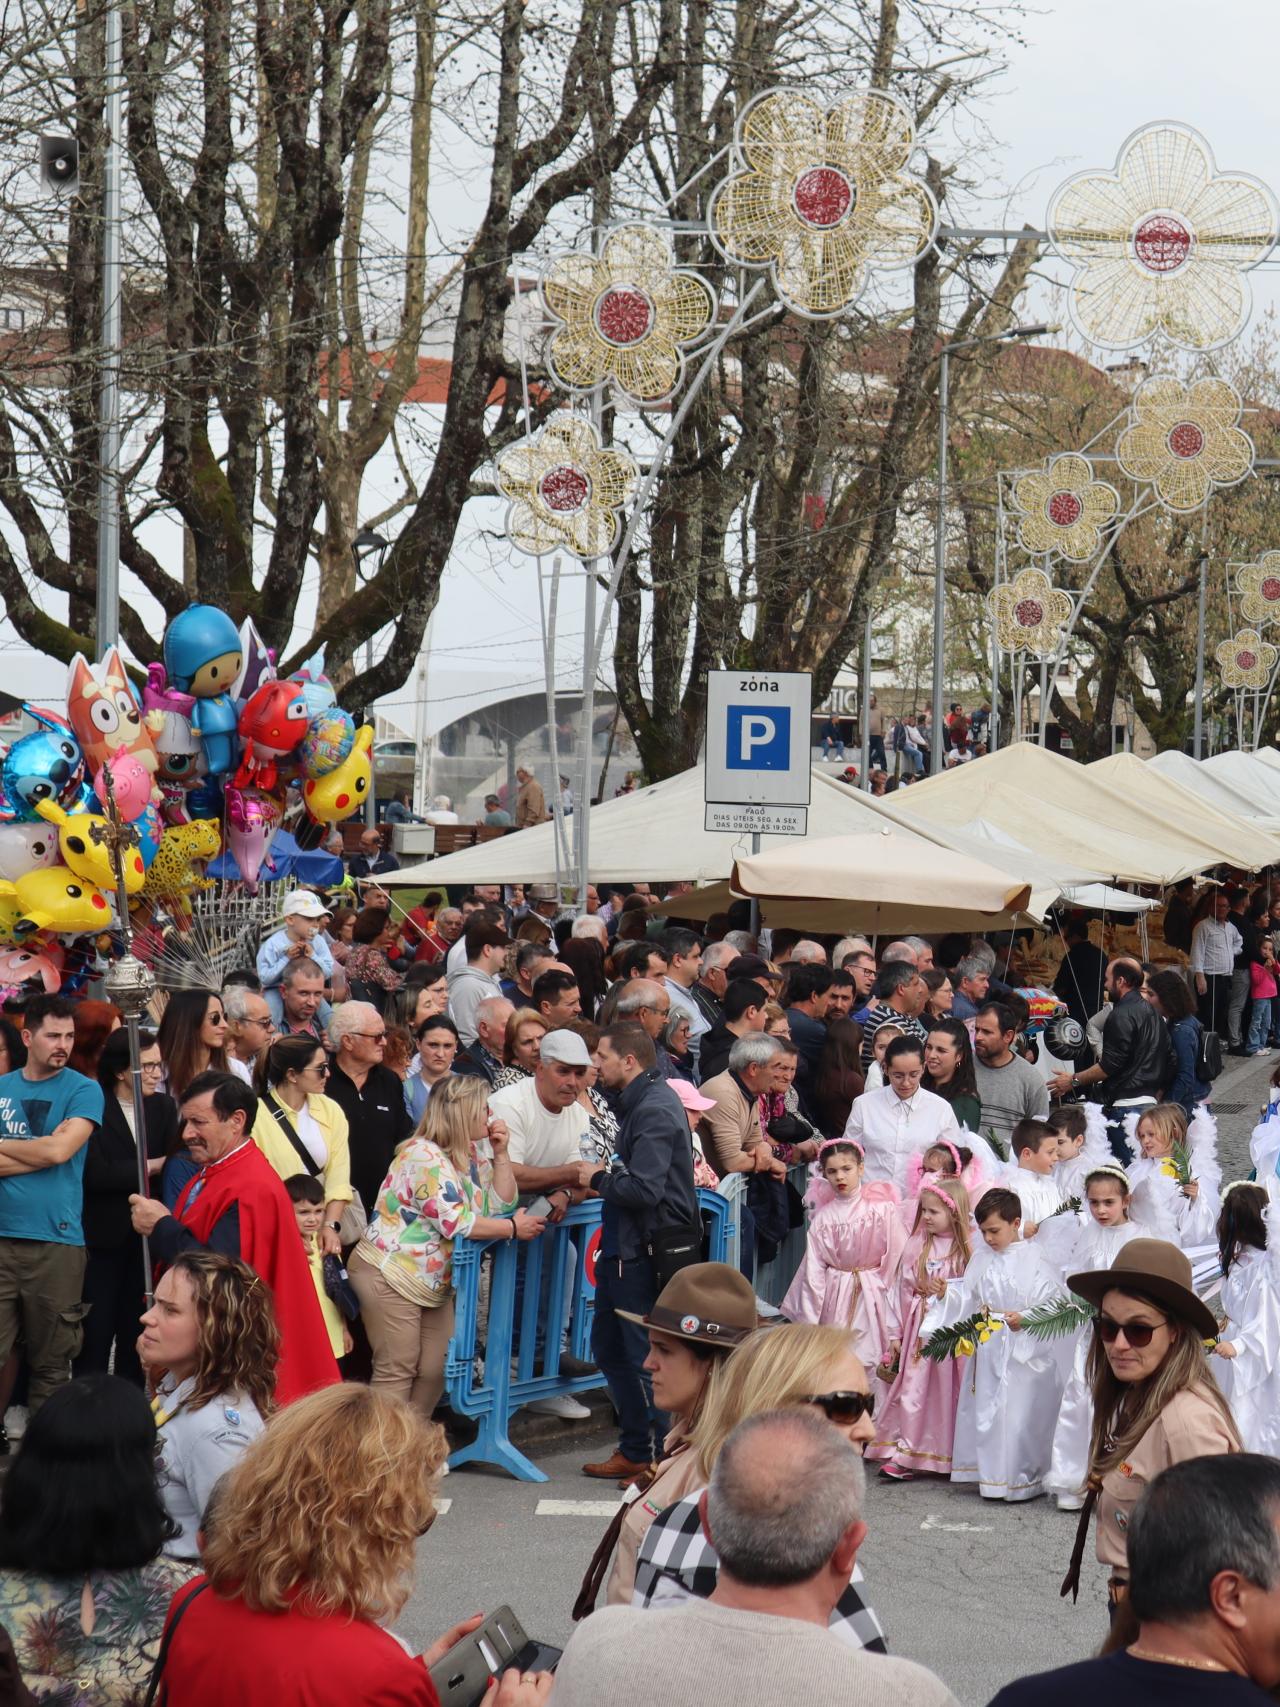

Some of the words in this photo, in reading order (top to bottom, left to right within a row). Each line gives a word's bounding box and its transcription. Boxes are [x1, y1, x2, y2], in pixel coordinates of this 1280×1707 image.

[739, 680, 780, 692] zona
[740, 714, 776, 761] P
[745, 807, 765, 815] PAGO
